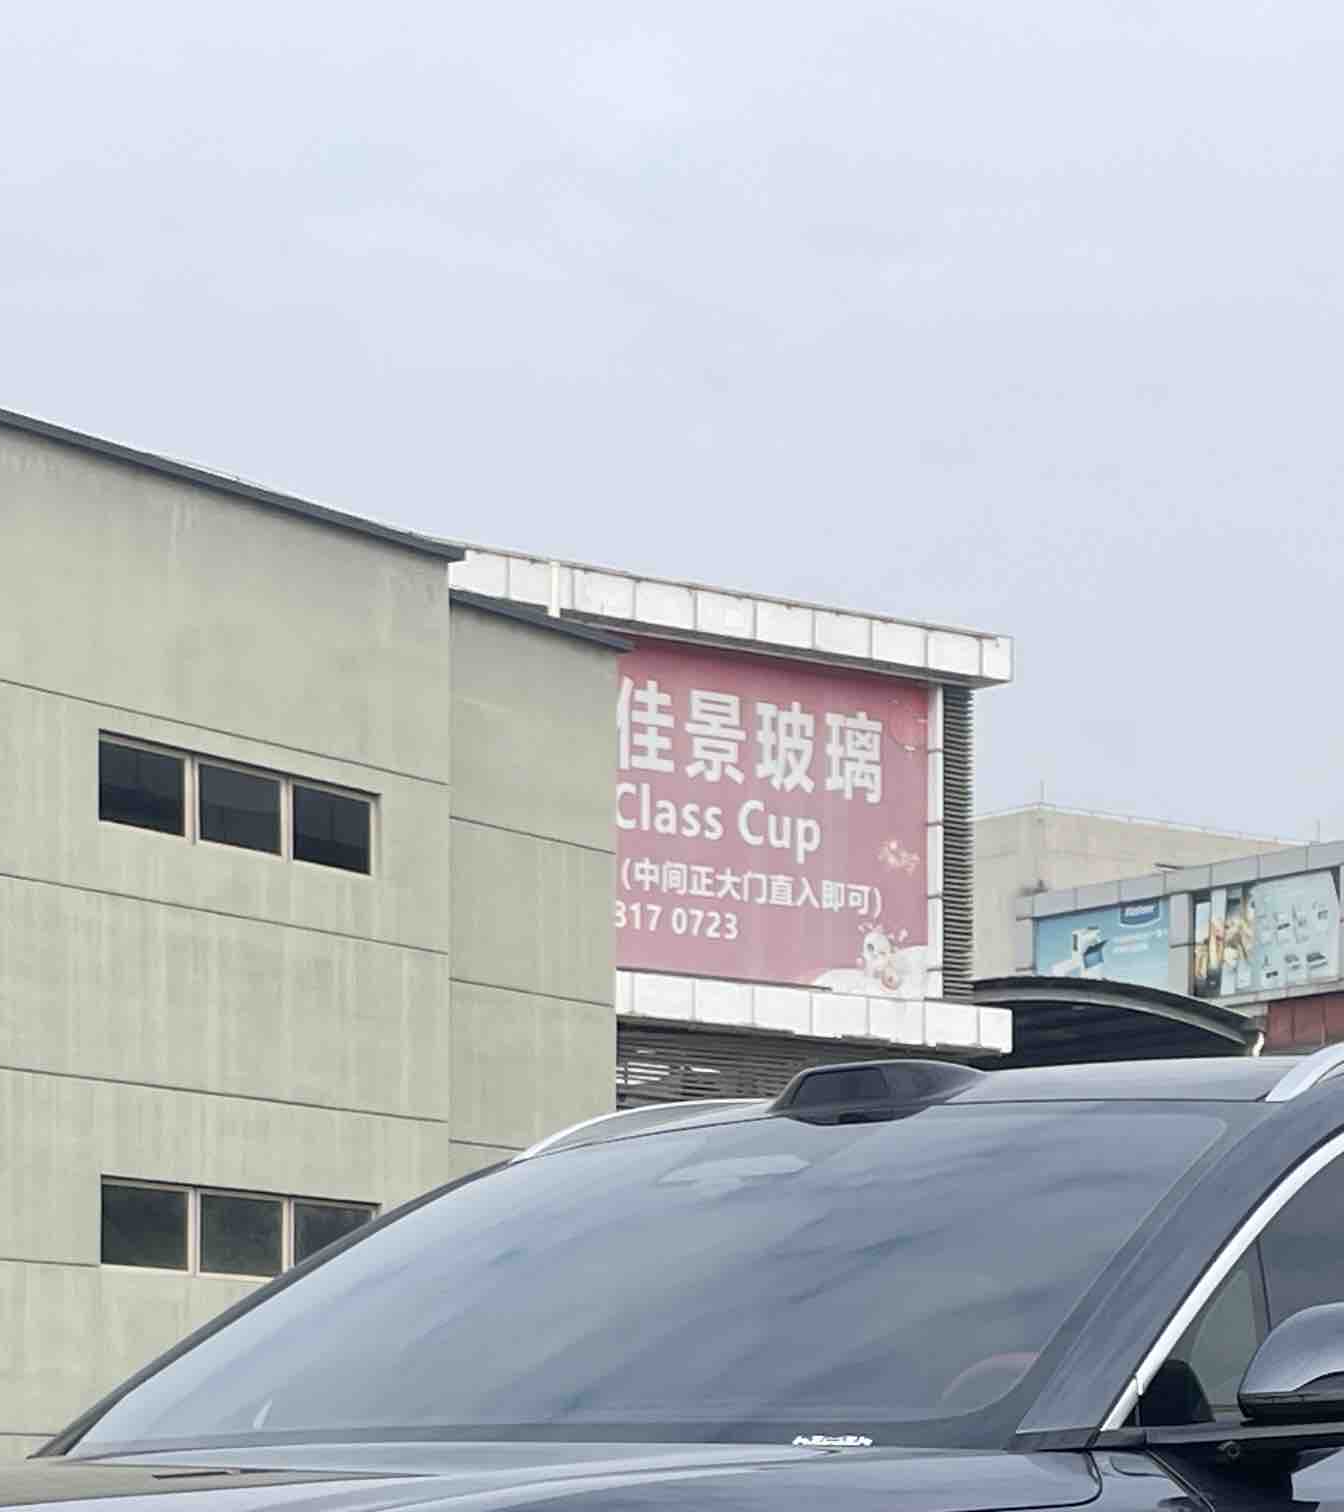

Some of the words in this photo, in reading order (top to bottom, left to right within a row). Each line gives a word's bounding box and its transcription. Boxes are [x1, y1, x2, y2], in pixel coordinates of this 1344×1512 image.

[616, 676, 883, 804] 佳景玻璃
[615, 782, 725, 841] Class
[737, 799, 822, 864] Cup
[671, 907, 739, 940] 0723
